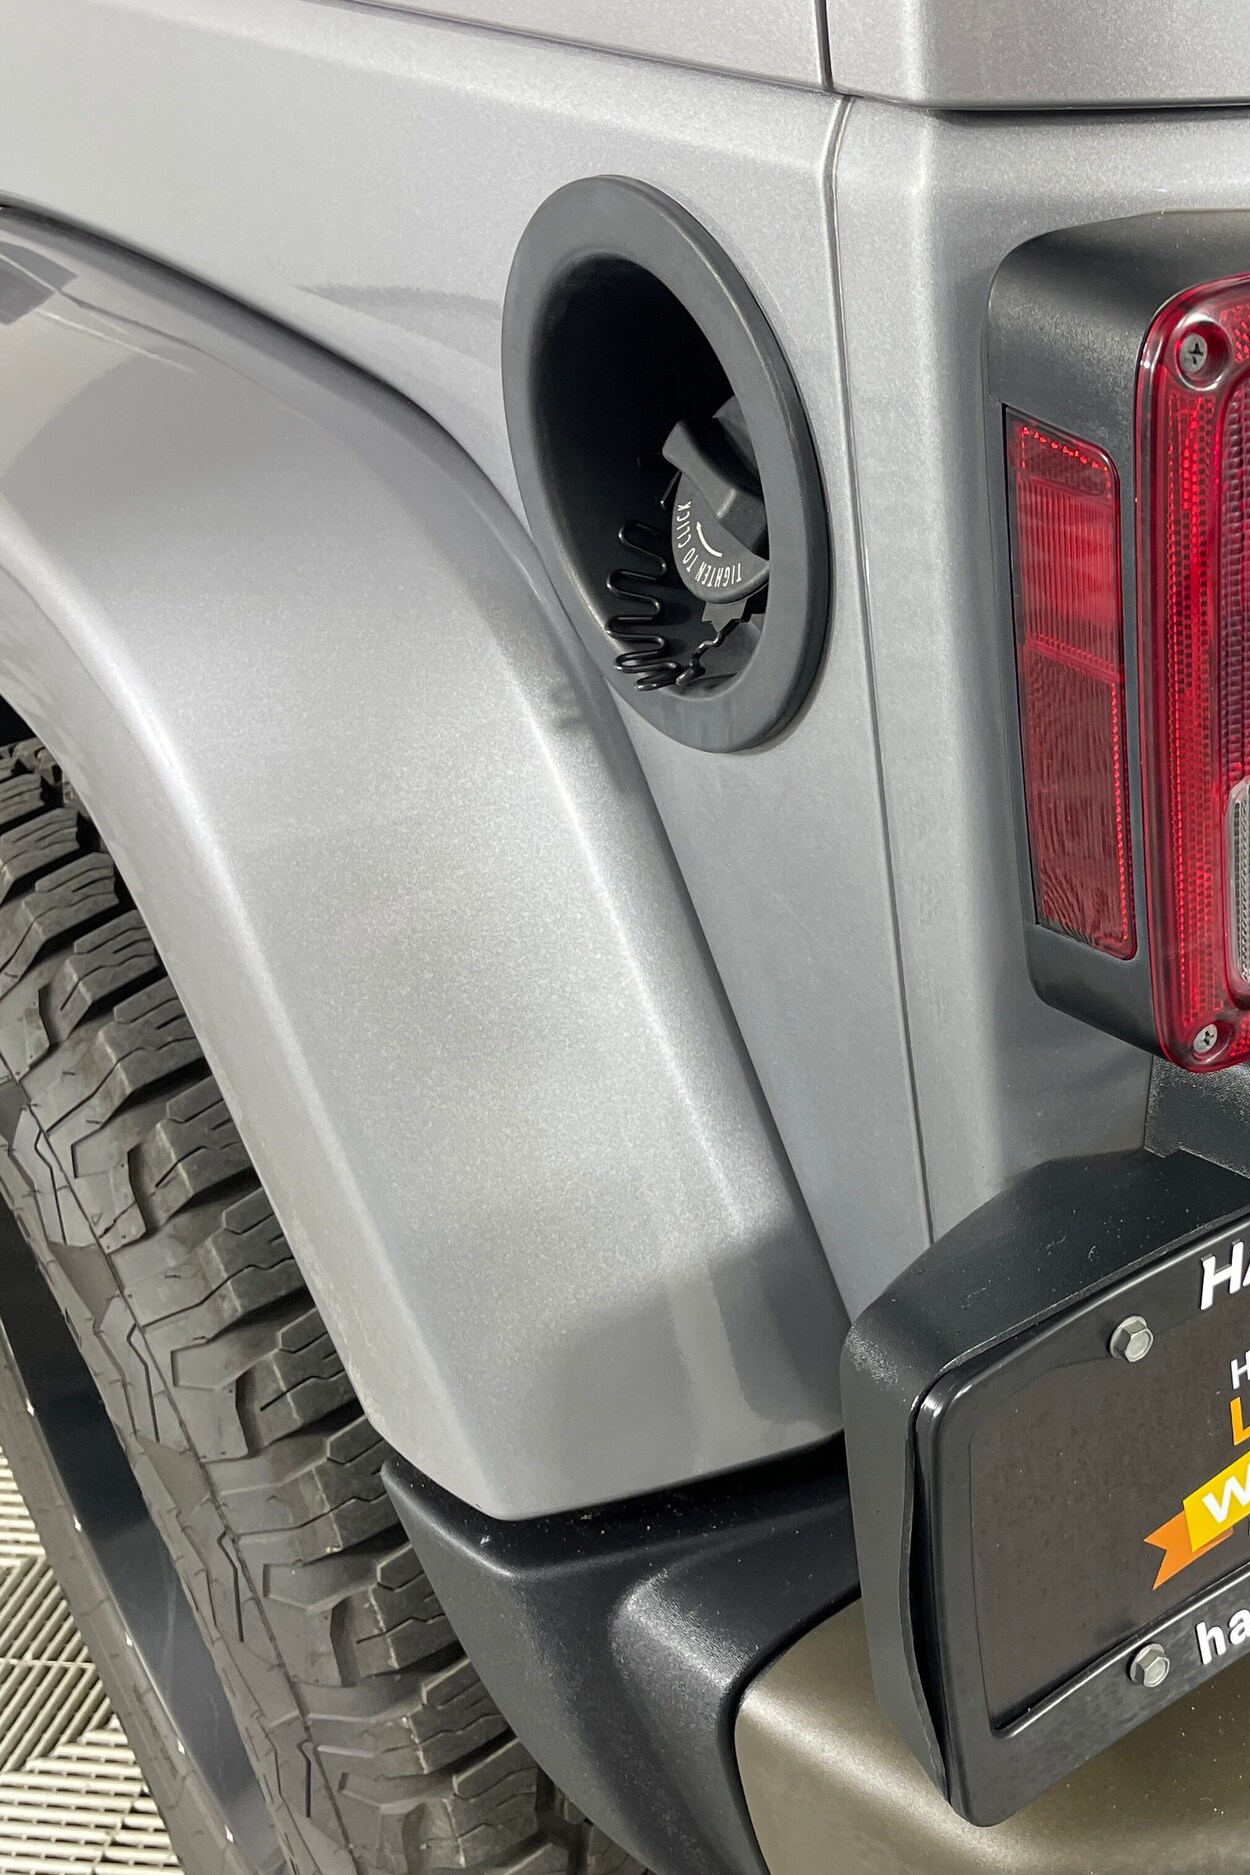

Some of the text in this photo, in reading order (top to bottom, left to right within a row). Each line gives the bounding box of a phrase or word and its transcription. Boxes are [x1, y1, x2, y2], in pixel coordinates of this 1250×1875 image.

[676, 501, 742, 588] TIGHTEN TO CLICK
